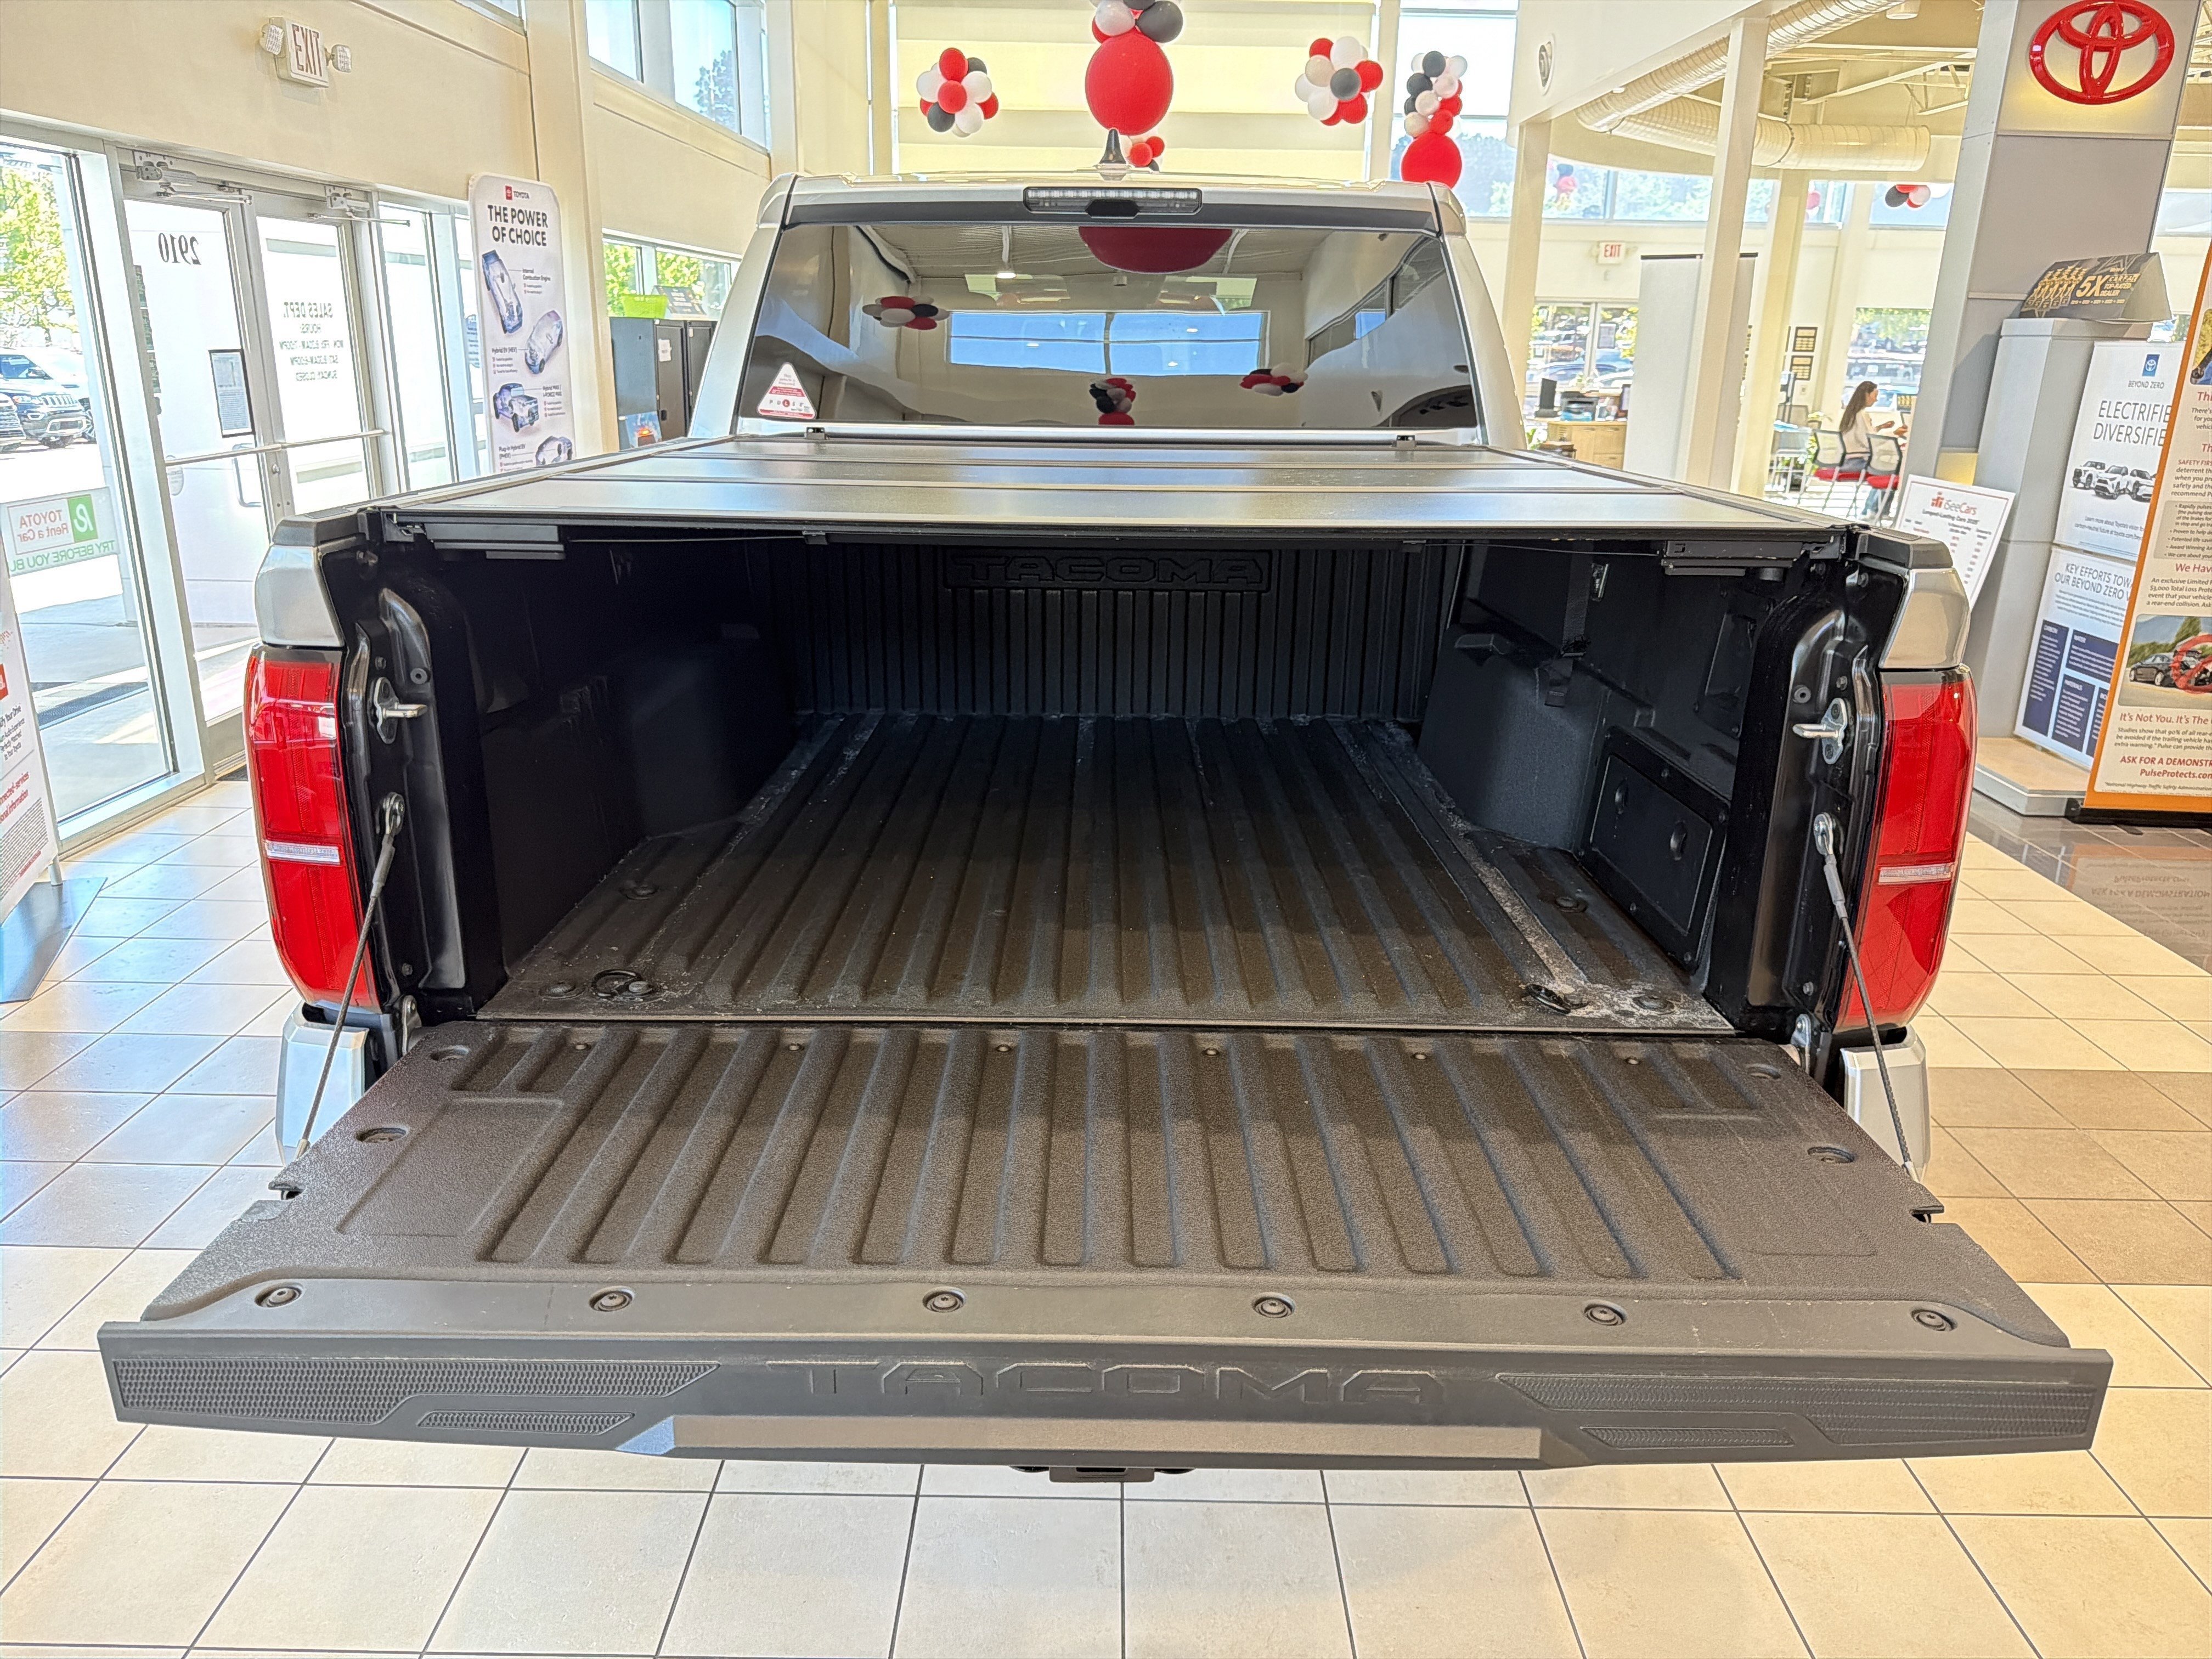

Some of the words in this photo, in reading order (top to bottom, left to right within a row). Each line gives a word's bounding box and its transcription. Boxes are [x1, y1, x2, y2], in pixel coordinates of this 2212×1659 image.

[291, 24, 323, 77] EXIT
[514, 191, 529, 199] TOYOTA
[488, 205, 508, 223] THE
[511, 208, 548, 228] POWER
[492, 226, 506, 242] OF
[509, 228, 546, 246] CHOICE
[1604, 244, 1622, 257] EXIT
[2076, 275, 2111, 297] 5X
[2108, 274, 2140, 283] CARFAX
[953, 554, 1262, 585] TACOMA
[2066, 563, 2079, 574] KEY
[2079, 566, 2112, 583] EFFORTS
[2113, 573, 2132, 588] TOW
[2176, 563, 2190, 572] We
[2055, 572, 2070, 585] OUR
[2072, 577, 2102, 594] BEYOND
[2103, 585, 2124, 600] ZERO
[2120, 713, 2133, 721] It's
[2135, 713, 2153, 723] Not
[2155, 714, 2174, 724] You.
[2176, 715, 2190, 724] It's
[2192, 715, 2209, 725] The
[2120, 755, 2138, 764] ASK
[2139, 757, 2156, 765] FOR
[766, 1361, 1444, 1404] TACOMA
